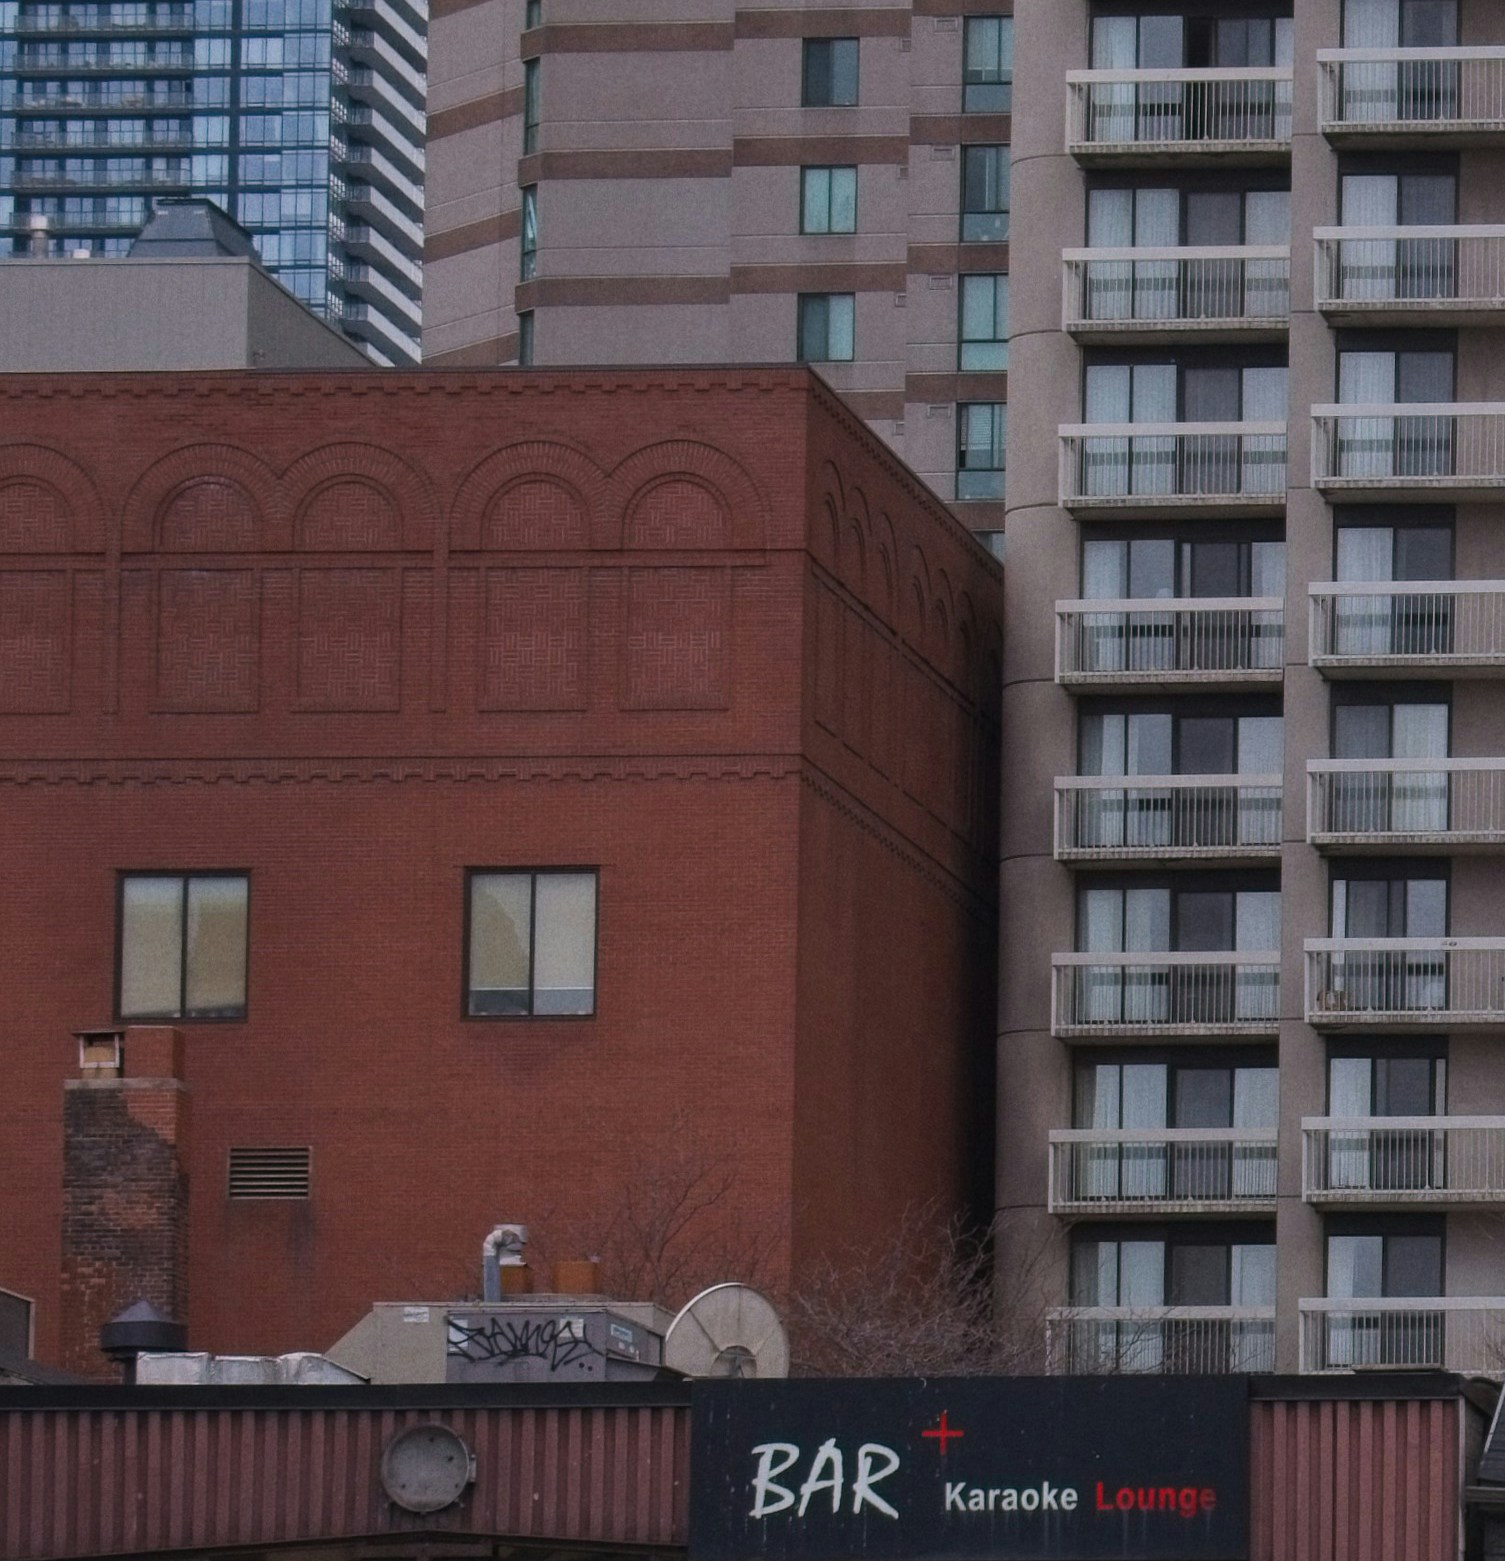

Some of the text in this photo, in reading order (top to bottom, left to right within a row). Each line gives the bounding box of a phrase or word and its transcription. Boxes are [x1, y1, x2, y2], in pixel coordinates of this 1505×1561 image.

[749, 1437, 901, 1519] BAR
[944, 1481, 1217, 1518] Karaoke Lounge
